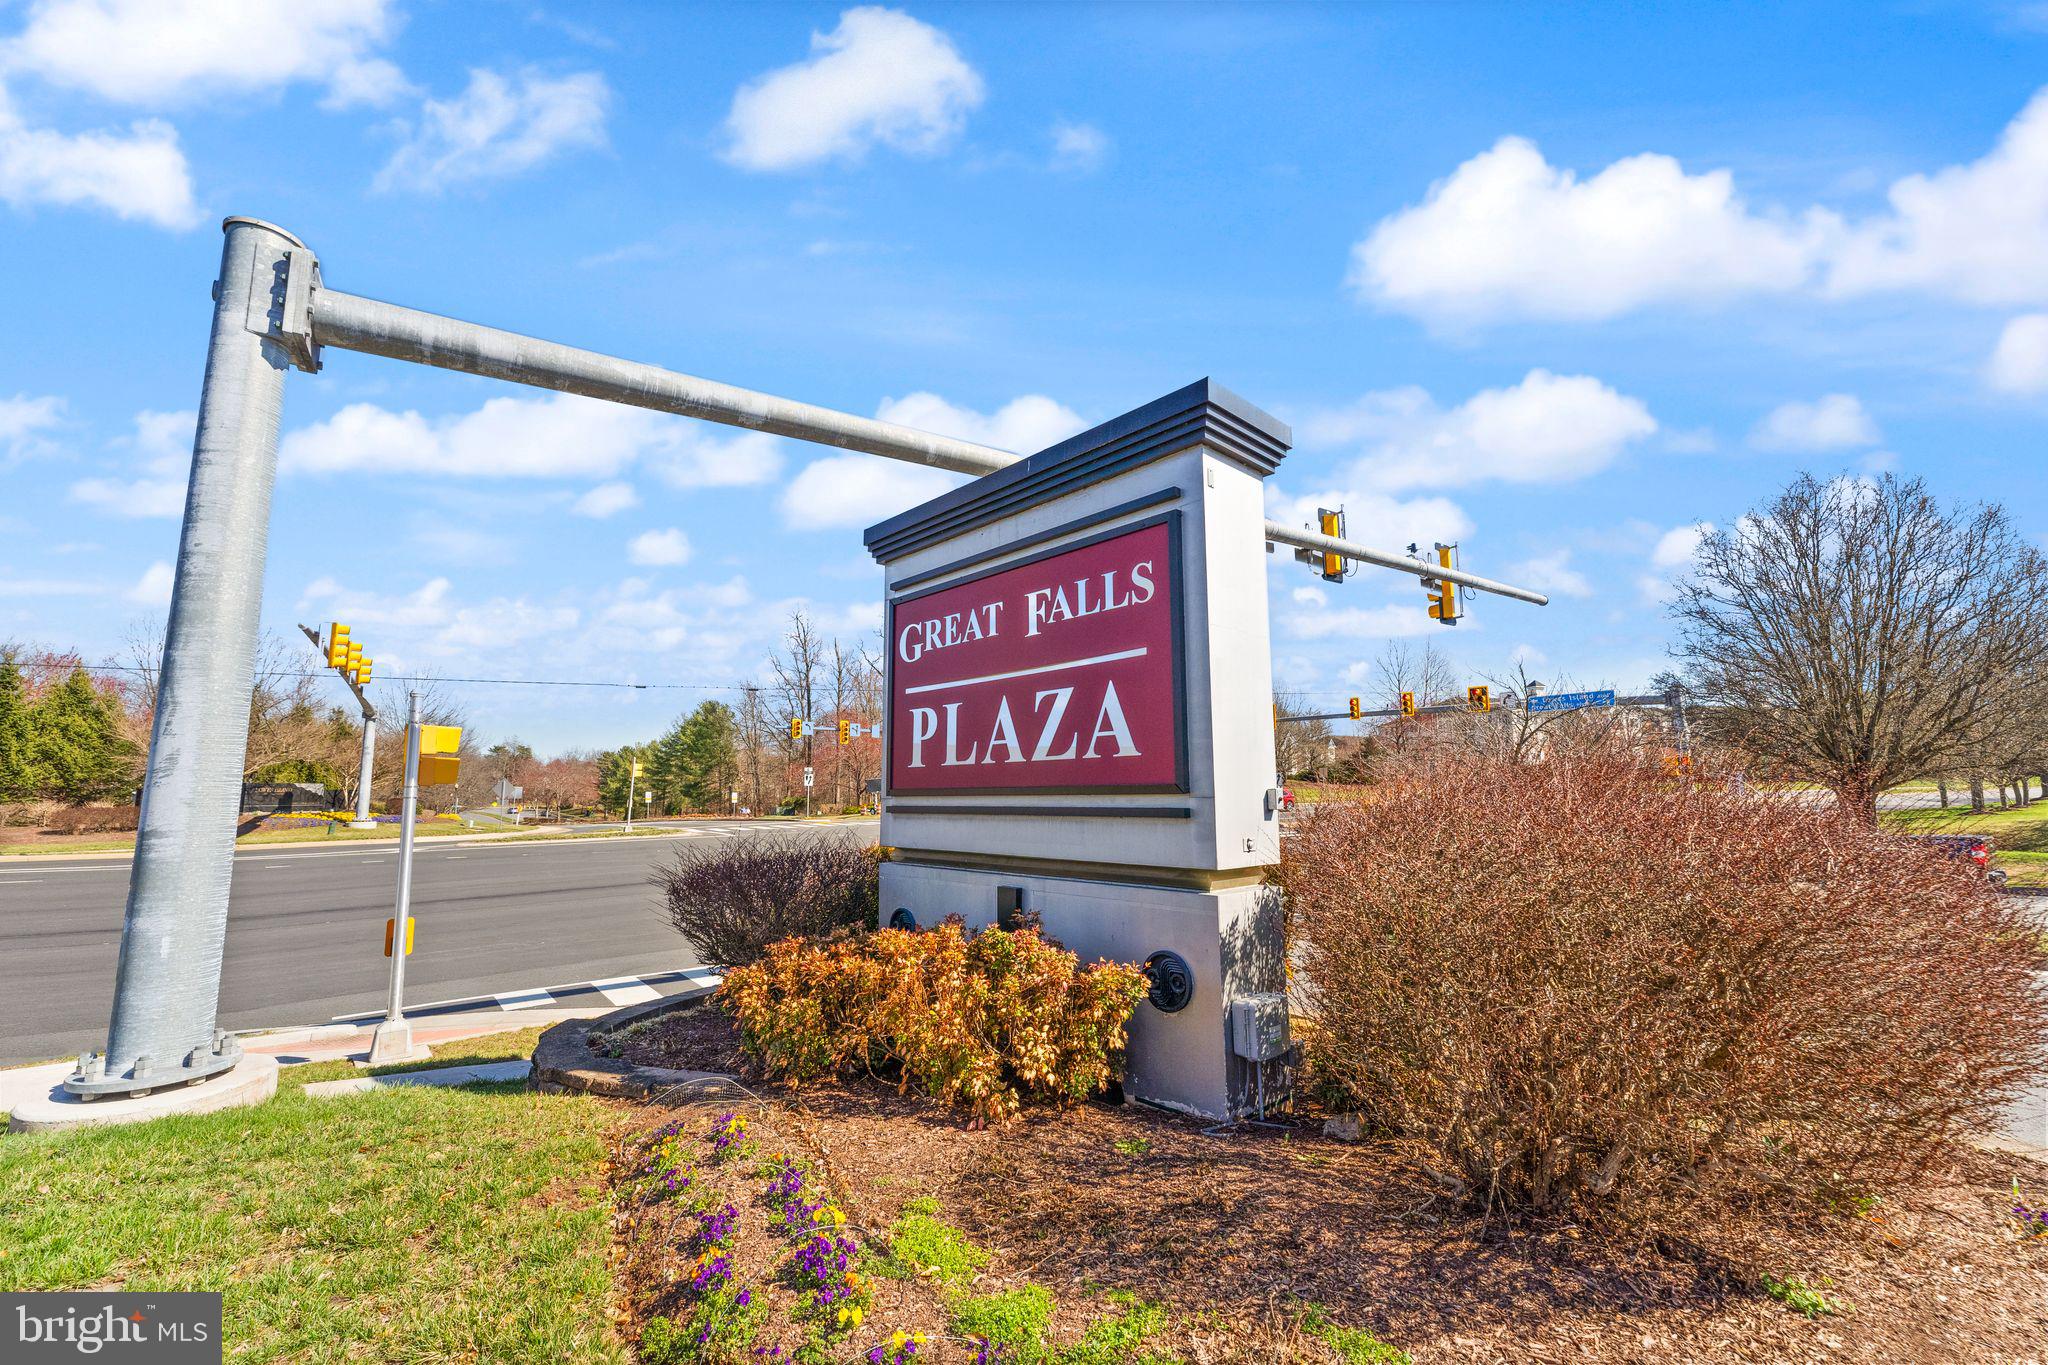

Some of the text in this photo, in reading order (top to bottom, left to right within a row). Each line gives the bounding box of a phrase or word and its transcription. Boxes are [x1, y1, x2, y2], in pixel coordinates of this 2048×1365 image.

[899, 560, 1156, 663] GREAT FALLS
[907, 679, 1142, 768] PLAZA
